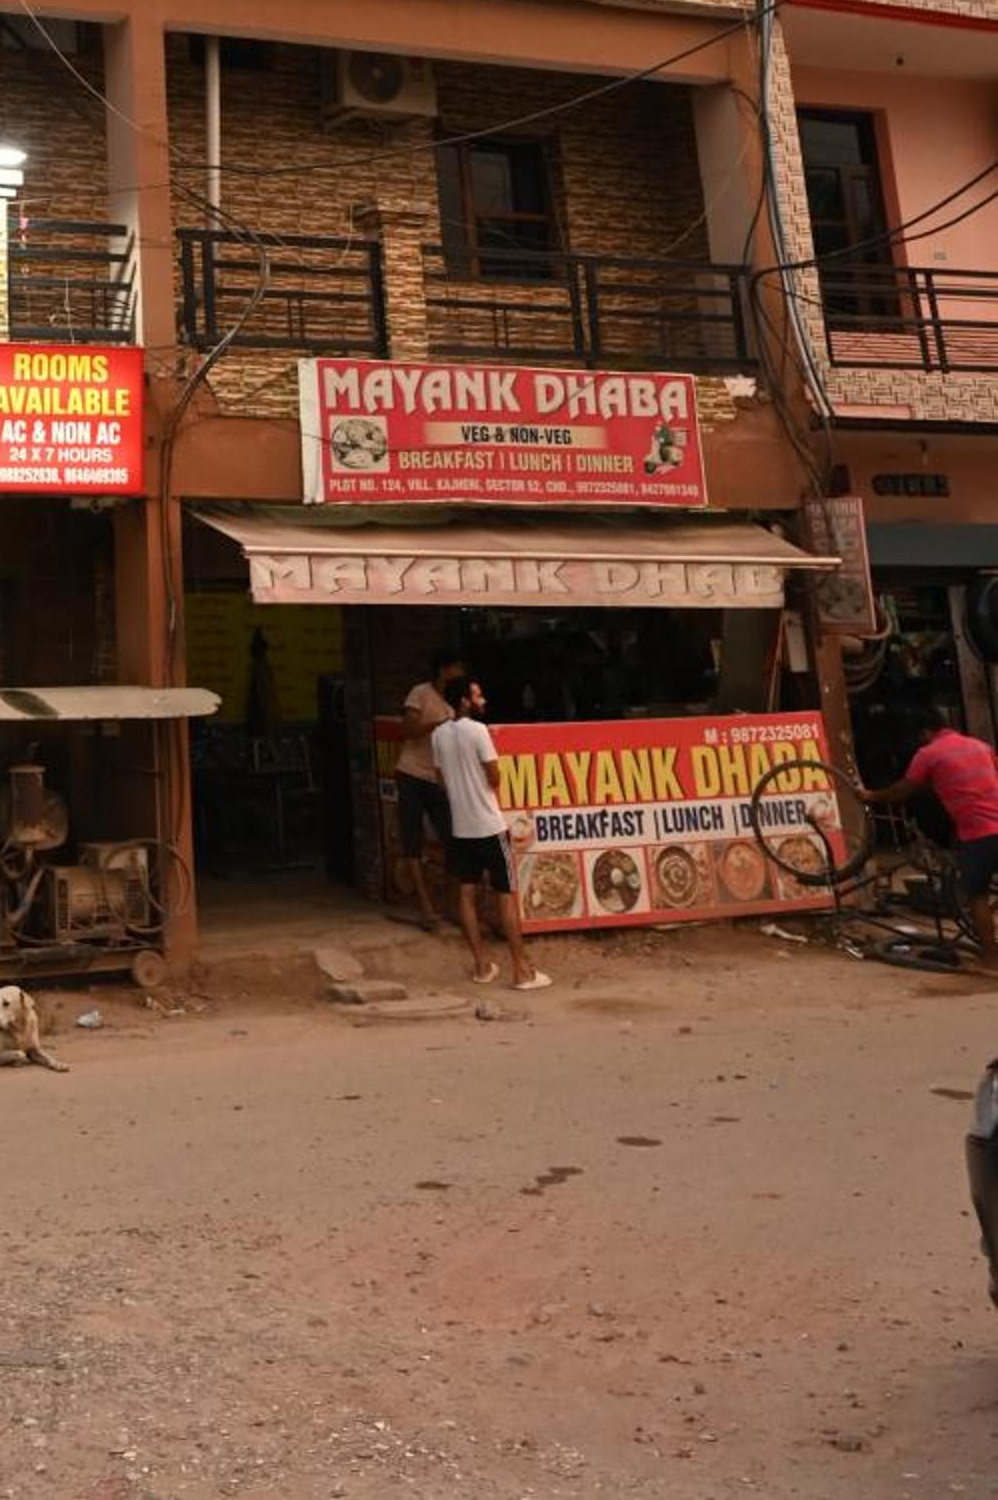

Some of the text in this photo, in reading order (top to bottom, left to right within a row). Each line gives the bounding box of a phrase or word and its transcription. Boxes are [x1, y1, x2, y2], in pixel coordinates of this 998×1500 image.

[13, 353, 109, 383] ROOMS
[323, 366, 689, 421] MAYANK DHABA
[1, 419, 121, 445] AC & NON AC
[461, 426, 489, 442] VEG
[510, 427, 572, 445] NON-VEG
[9, 447, 27, 462] 24
[45, 447, 55, 462] 7
[58, 448, 113, 463] HOURS
[398, 451, 634, 473] BREAKFAST LUNCH DINNER
[329, 479, 355, 492] PLOT
[253, 553, 570, 596] MAYANK
[497, 739, 830, 808] MAYANK DHABA
[536, 809, 644, 841] BREAKFAST
[740, 800, 807, 828] DNNER
